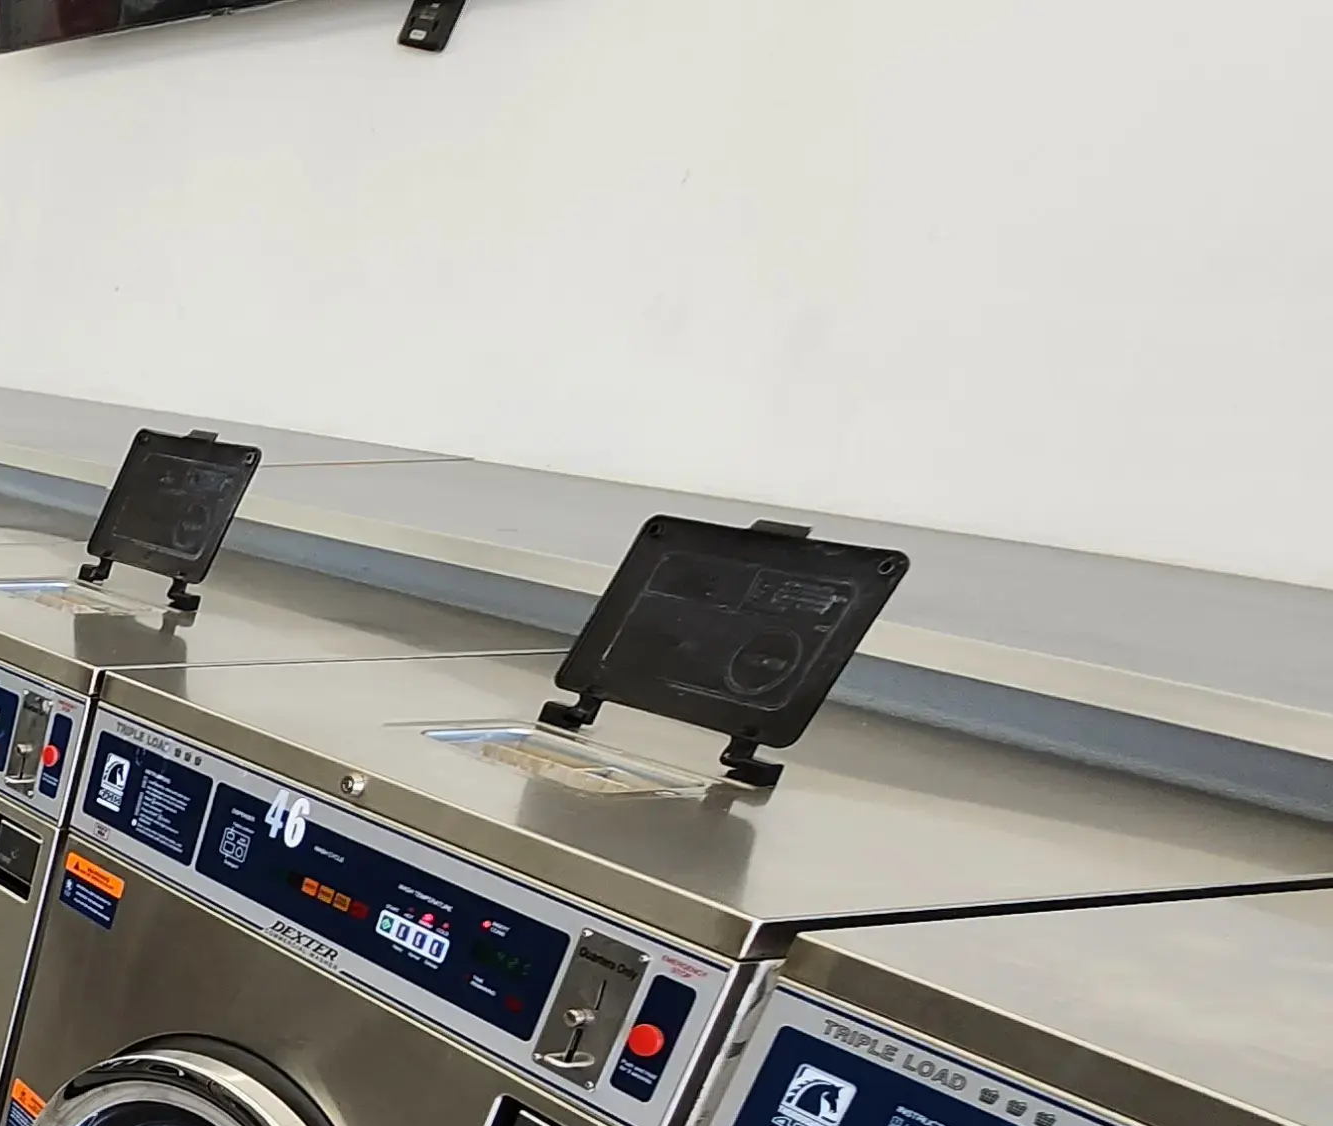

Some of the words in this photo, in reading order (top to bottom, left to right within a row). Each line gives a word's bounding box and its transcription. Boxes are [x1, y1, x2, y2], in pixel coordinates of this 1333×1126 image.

[264, 788, 311, 848] 46
[269, 920, 339, 962] DEXTER
[823, 1018, 899, 1063] TRIPLE
[902, 1054, 968, 1093] LOAD
